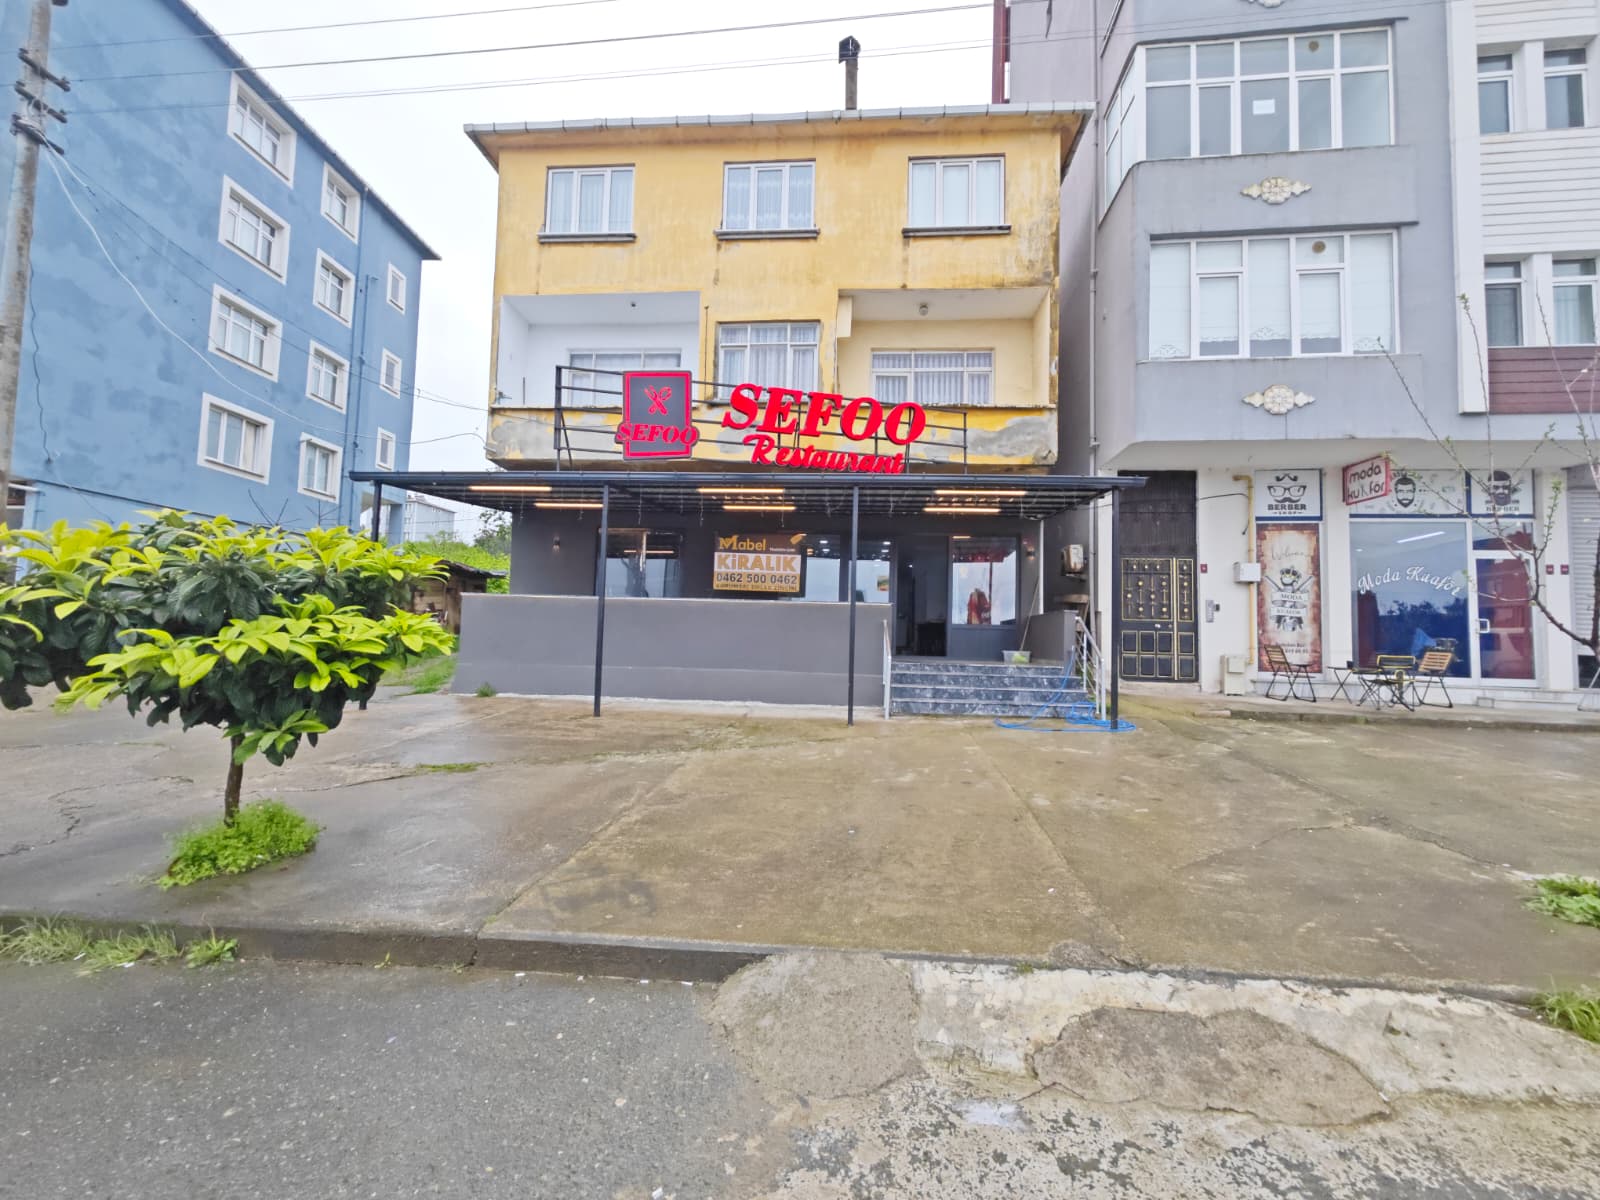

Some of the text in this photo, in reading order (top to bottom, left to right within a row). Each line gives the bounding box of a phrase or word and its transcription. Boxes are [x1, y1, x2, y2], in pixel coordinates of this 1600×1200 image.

[721, 382, 926, 446] SEFOO
[616, 422, 699, 445] SEFOO
[742, 434, 905, 473] Restaurant
[1349, 463, 1382, 484] moda
[1267, 503, 1307, 511] BERBER
[719, 535, 766, 551] Mabel
[716, 573, 797, 584] 0462 500 0462
[1358, 567, 1401, 594] Moda
